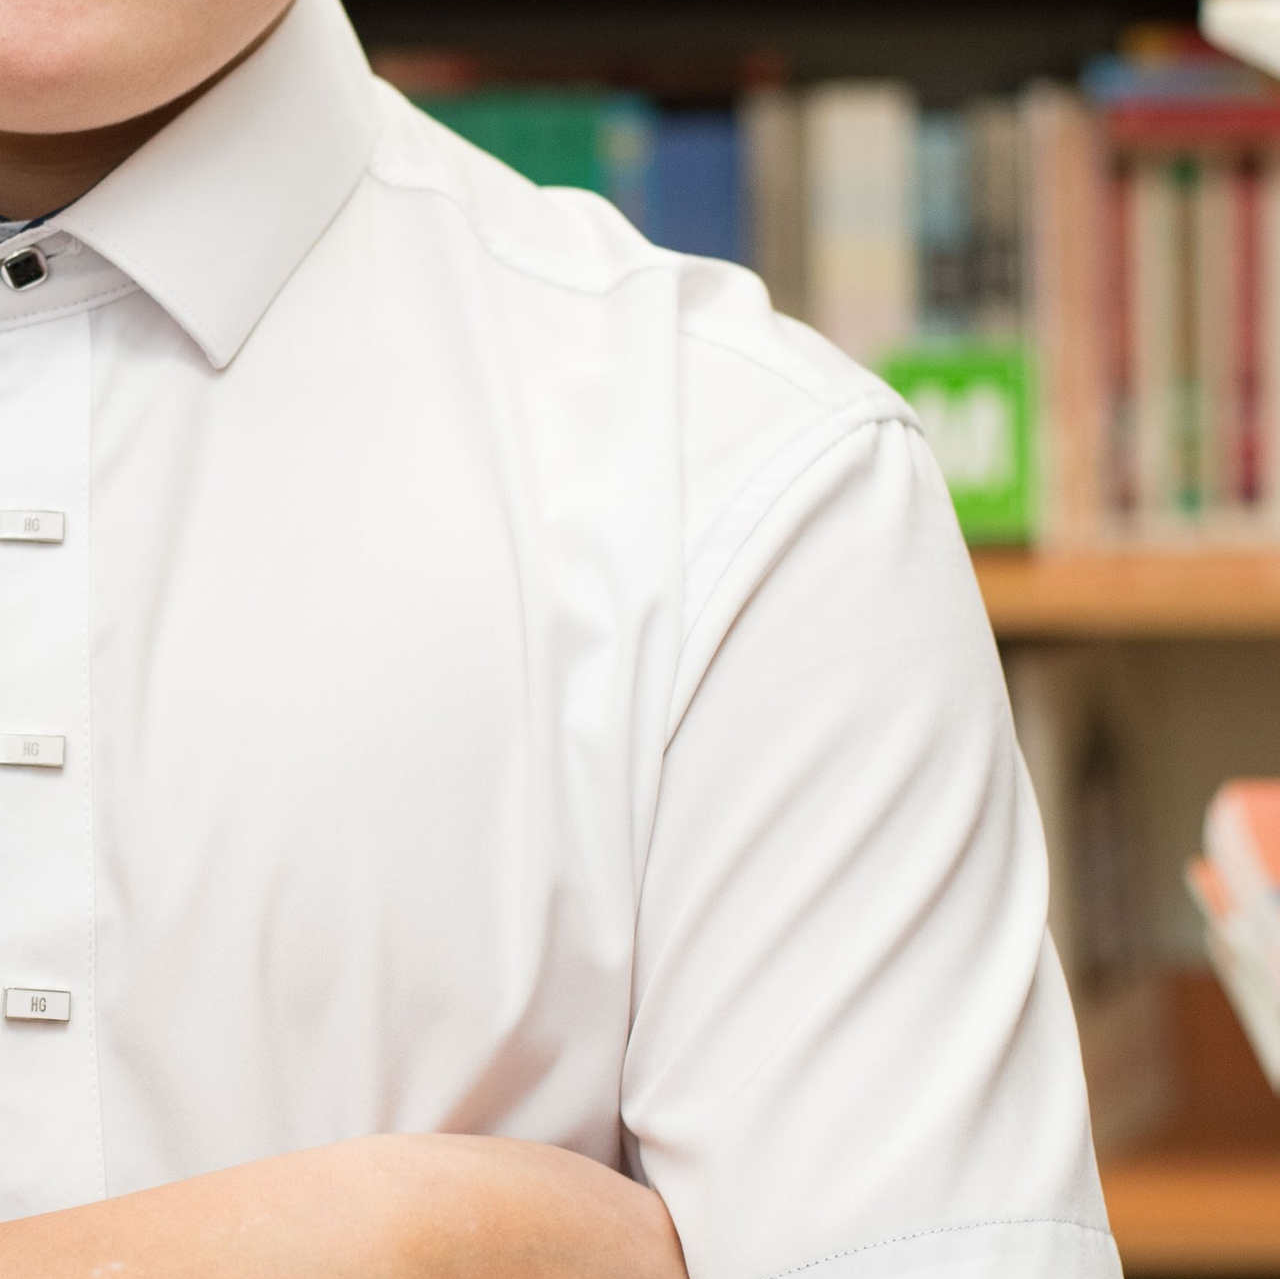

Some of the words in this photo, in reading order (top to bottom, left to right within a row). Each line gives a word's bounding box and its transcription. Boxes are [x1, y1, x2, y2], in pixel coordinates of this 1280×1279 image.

[23, 516, 41, 532] HG
[22, 740, 40, 757] HG
[30, 996, 47, 1013] HG
